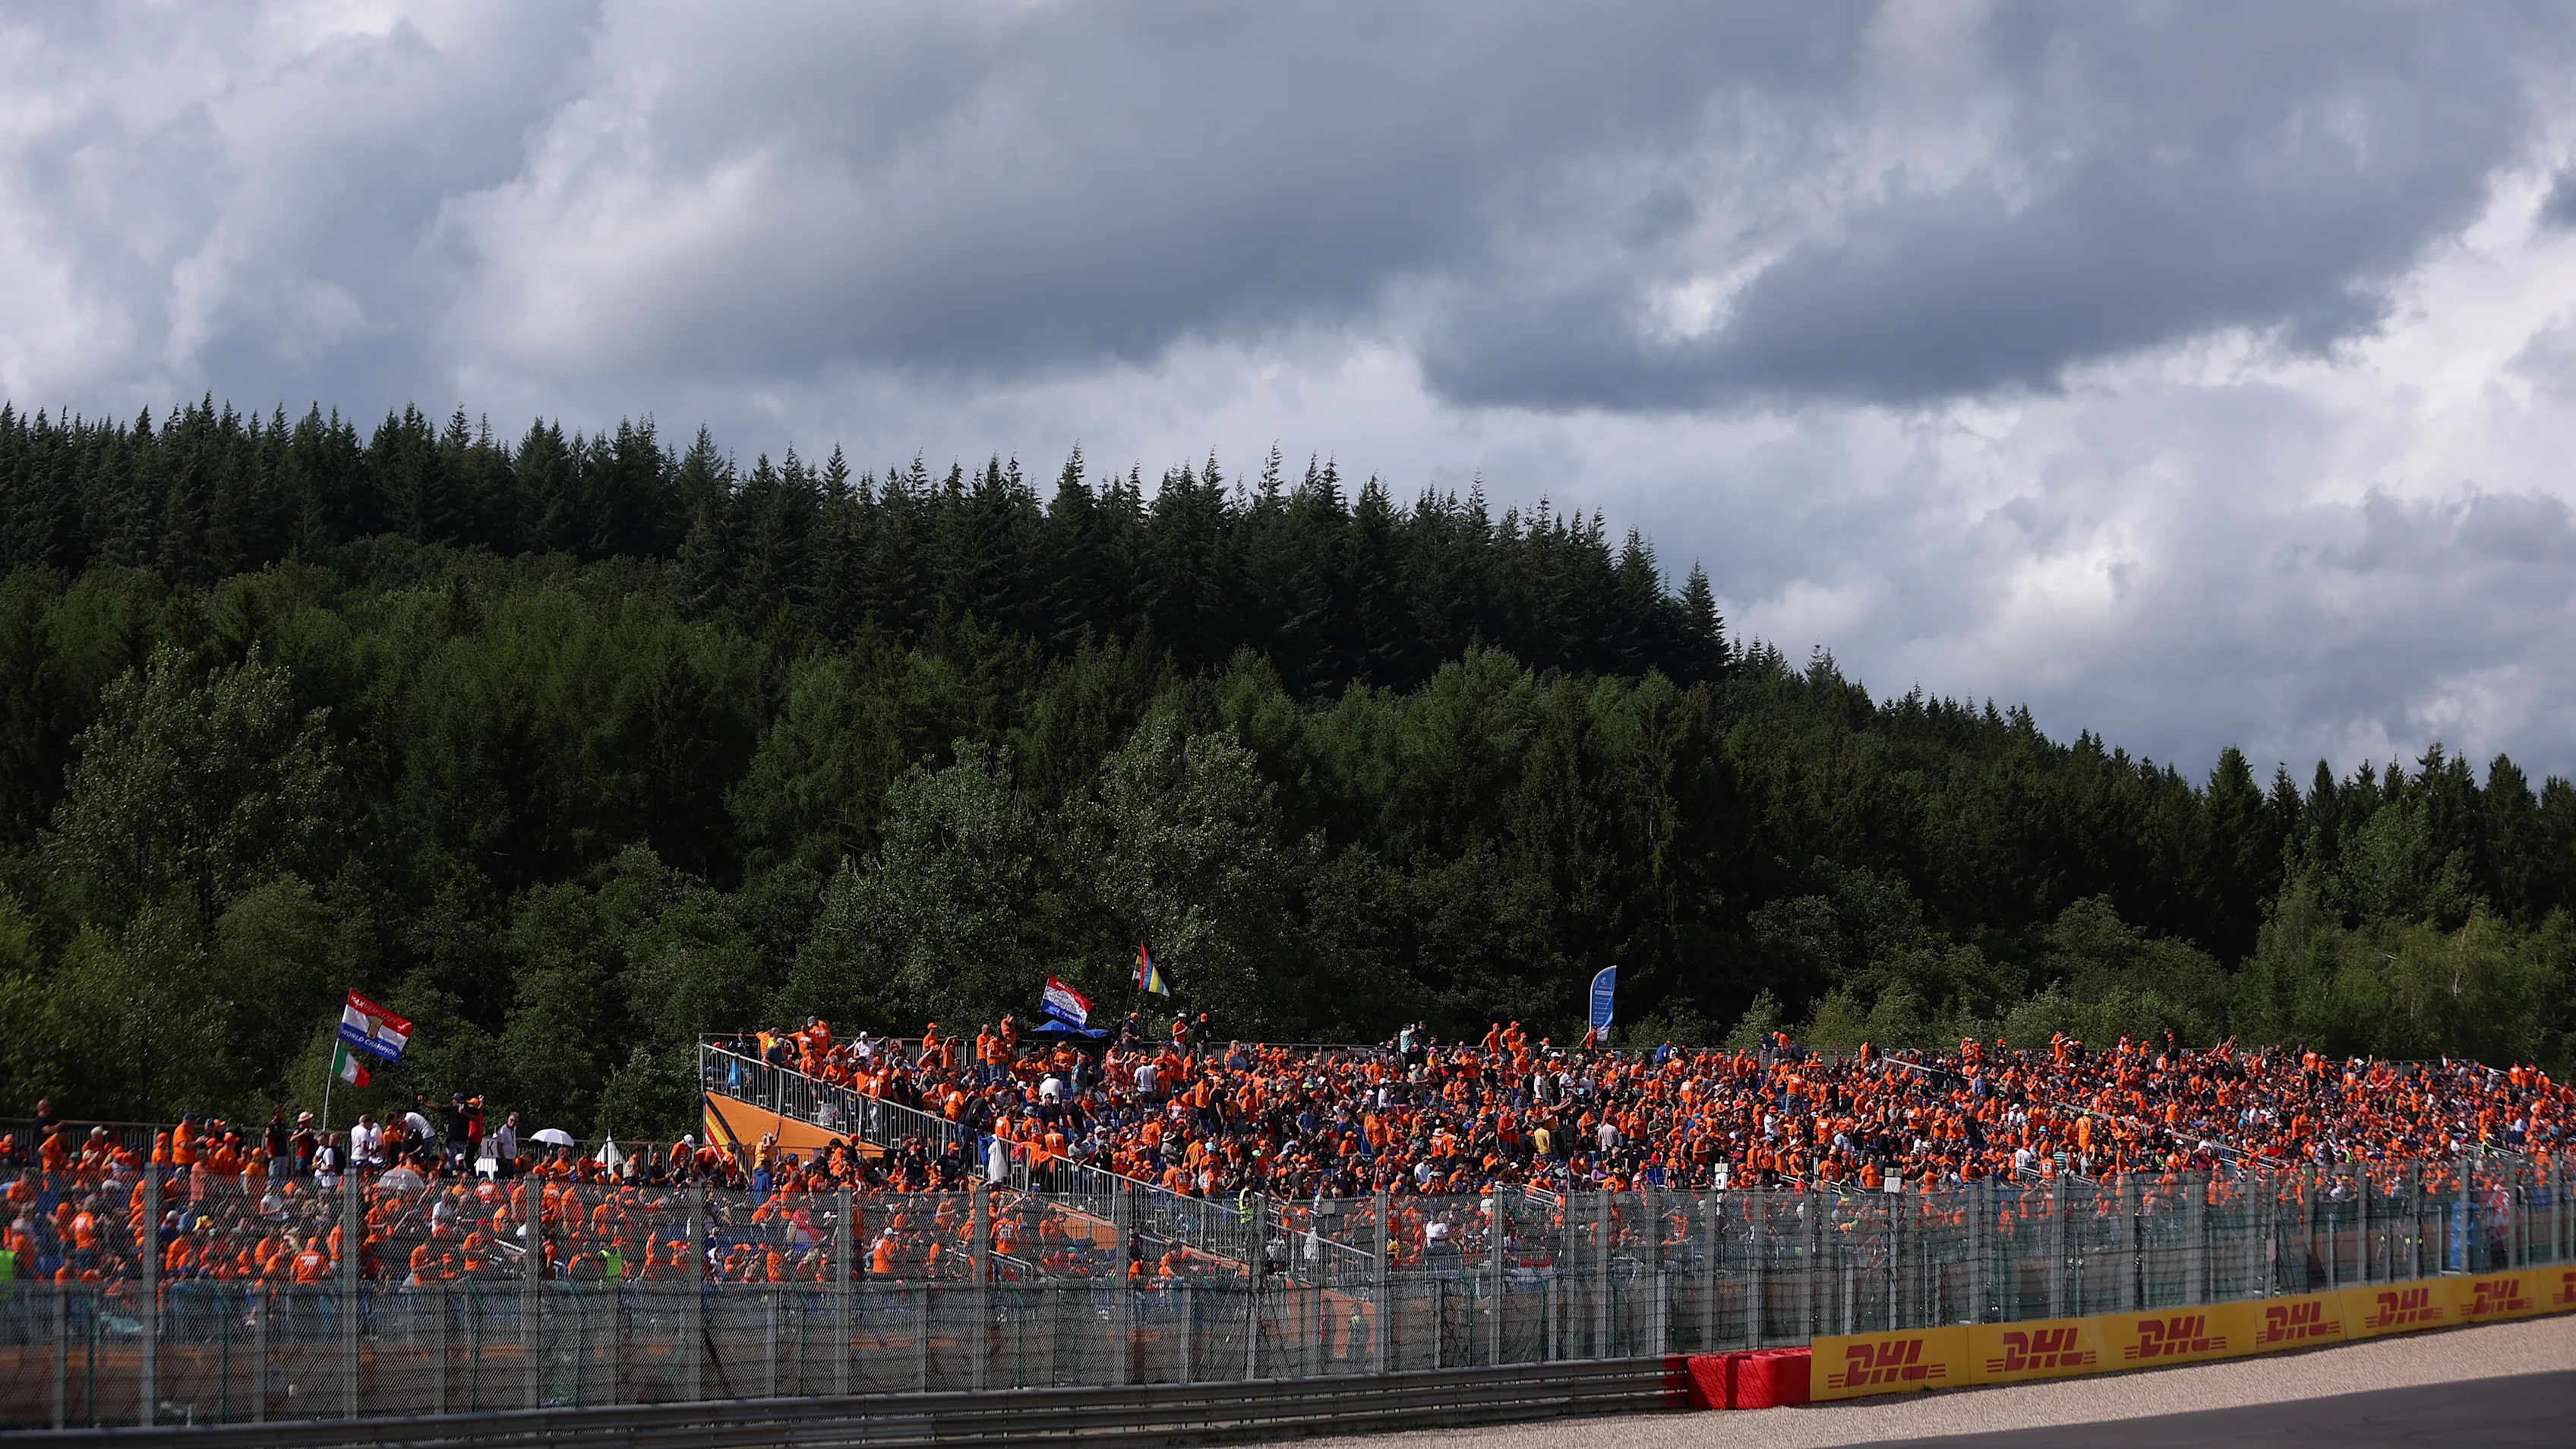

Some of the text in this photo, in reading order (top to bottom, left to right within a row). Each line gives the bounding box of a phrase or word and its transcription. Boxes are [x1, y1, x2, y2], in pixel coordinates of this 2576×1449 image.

[341, 1029, 397, 1057] WORLD CHAMPION
[366, 1015, 384, 1040] 1
[486, 1141, 494, 1156] K
[1052, 1135, 1057, 1148] 1
[2377, 1288, 2434, 1327] DHL
[2473, 1279, 2525, 1315] DHL
[2137, 1315, 2211, 1359] DHL
[2266, 1302, 2328, 1343] DHL
[1843, 1339, 1929, 1387] DHL
[2003, 1327, 2084, 1372] DHL
